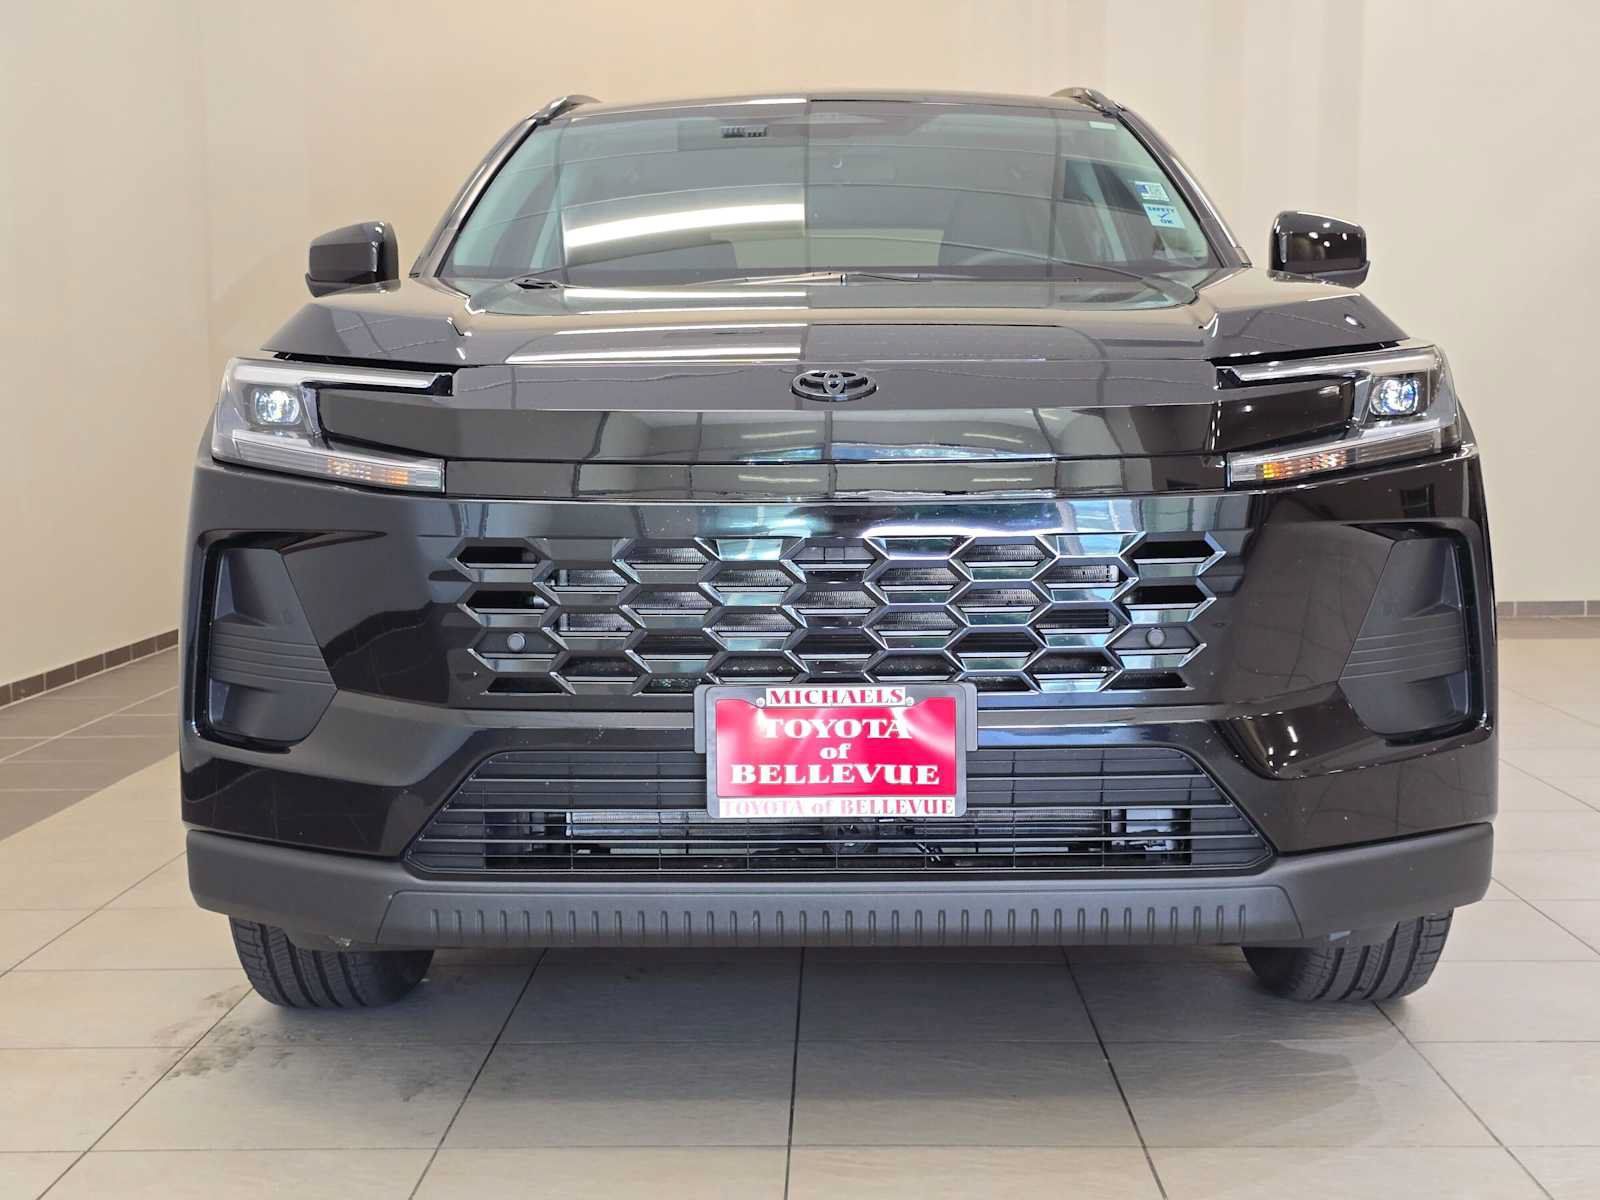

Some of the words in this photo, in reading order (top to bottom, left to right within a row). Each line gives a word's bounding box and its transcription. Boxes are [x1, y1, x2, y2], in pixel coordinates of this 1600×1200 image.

[770, 689, 904, 705] MICHAELS
[763, 718, 912, 739] TOYOTA
[819, 743, 853, 760] of
[730, 763, 940, 785] BELLEVUE
[721, 799, 806, 815] TOYOTA
[811, 798, 834, 815] of
[840, 799, 954, 815] BELLEVUE
